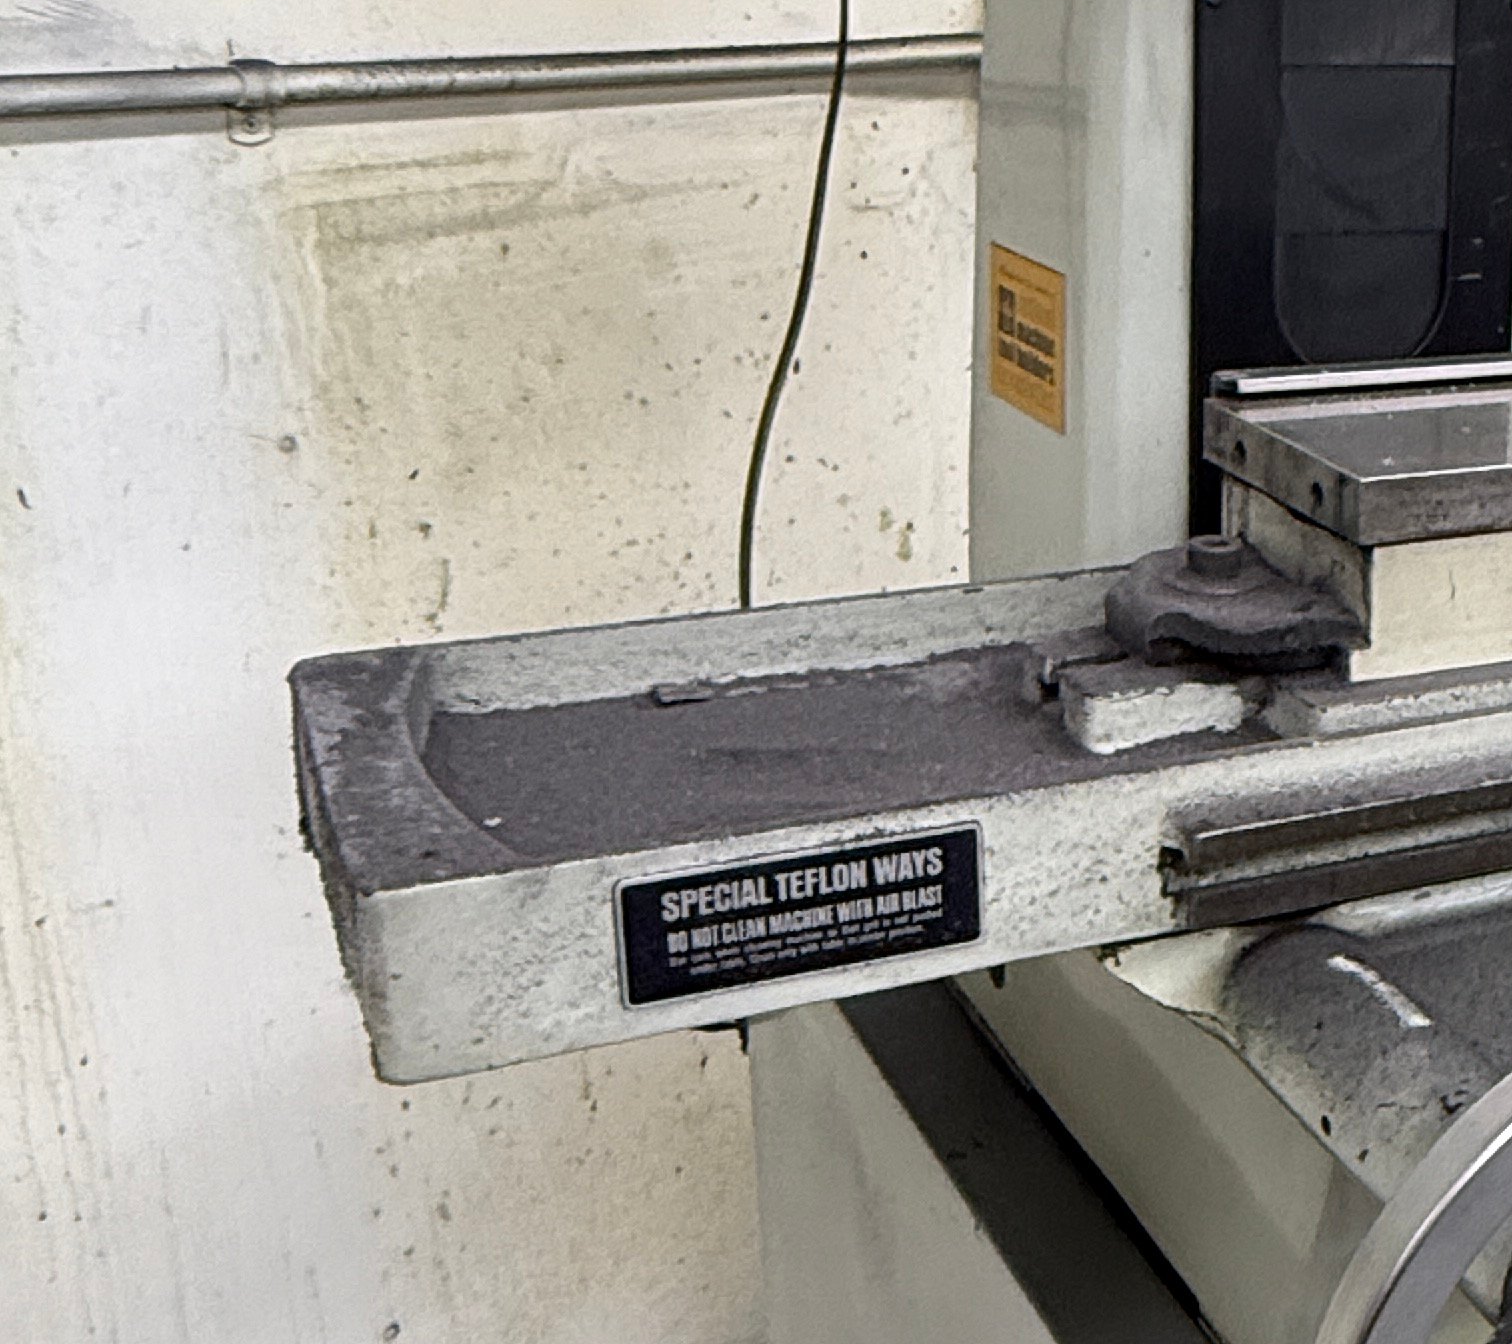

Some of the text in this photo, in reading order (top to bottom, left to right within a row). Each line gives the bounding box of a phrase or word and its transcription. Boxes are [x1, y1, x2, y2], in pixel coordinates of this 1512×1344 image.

[661, 847, 944, 922] SPECIAL TEFLON WAYS
[667, 930, 688, 954] DO
[691, 925, 720, 949] NOT
[721, 916, 767, 944] CLEAN
[768, 904, 835, 935] MACHINE
[837, 897, 874, 923] WITH
[877, 892, 900, 915] AIR
[902, 884, 943, 911] BLAST
